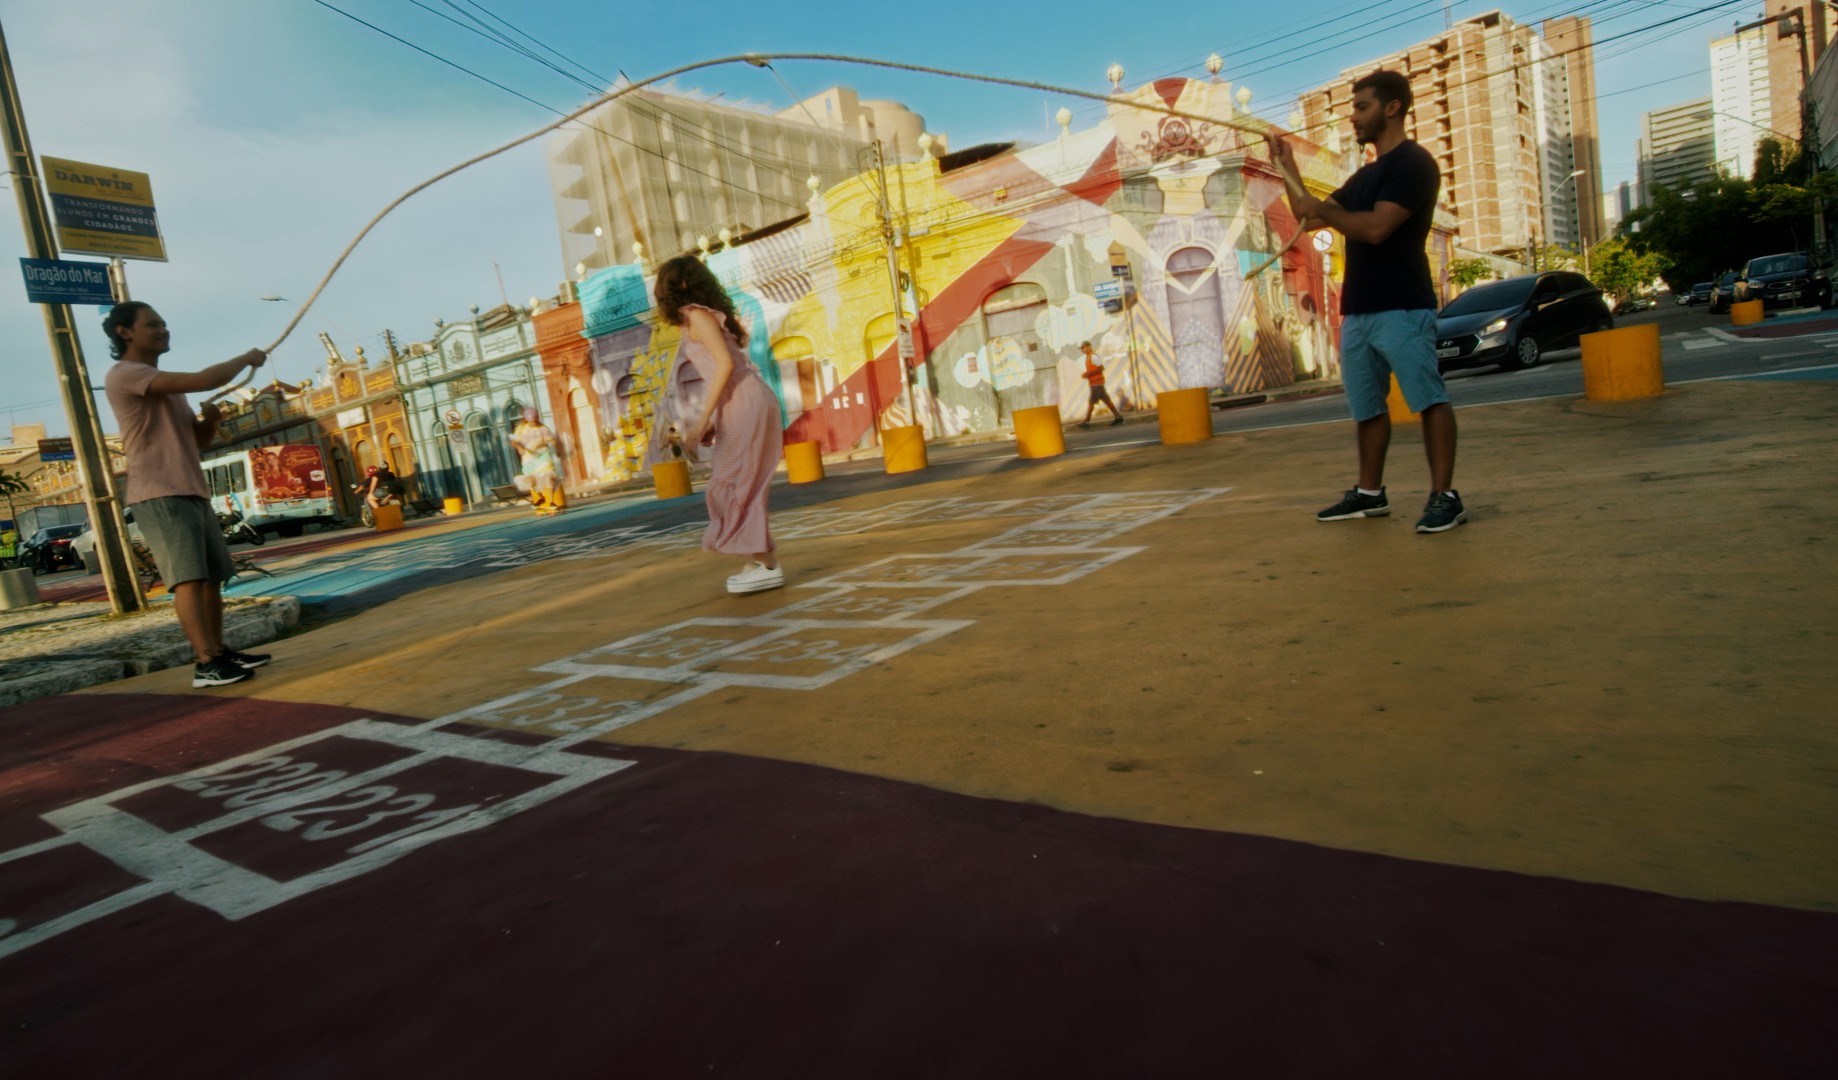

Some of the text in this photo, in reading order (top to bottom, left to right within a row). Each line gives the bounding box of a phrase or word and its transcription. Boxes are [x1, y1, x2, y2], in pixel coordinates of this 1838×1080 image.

[55, 170, 134, 191] DARWIN
[57, 208, 155, 225] ALUNOS EM GRANDES
[64, 198, 144, 216] TRANSFORMANDO
[25, 264, 103, 285] Dragão do Mar
[604, 636, 739, 660] 233
[723, 639, 884, 664] 234
[469, 692, 644, 732] 232
[172, 756, 348, 809] 230
[260, 785, 483, 853] 231
